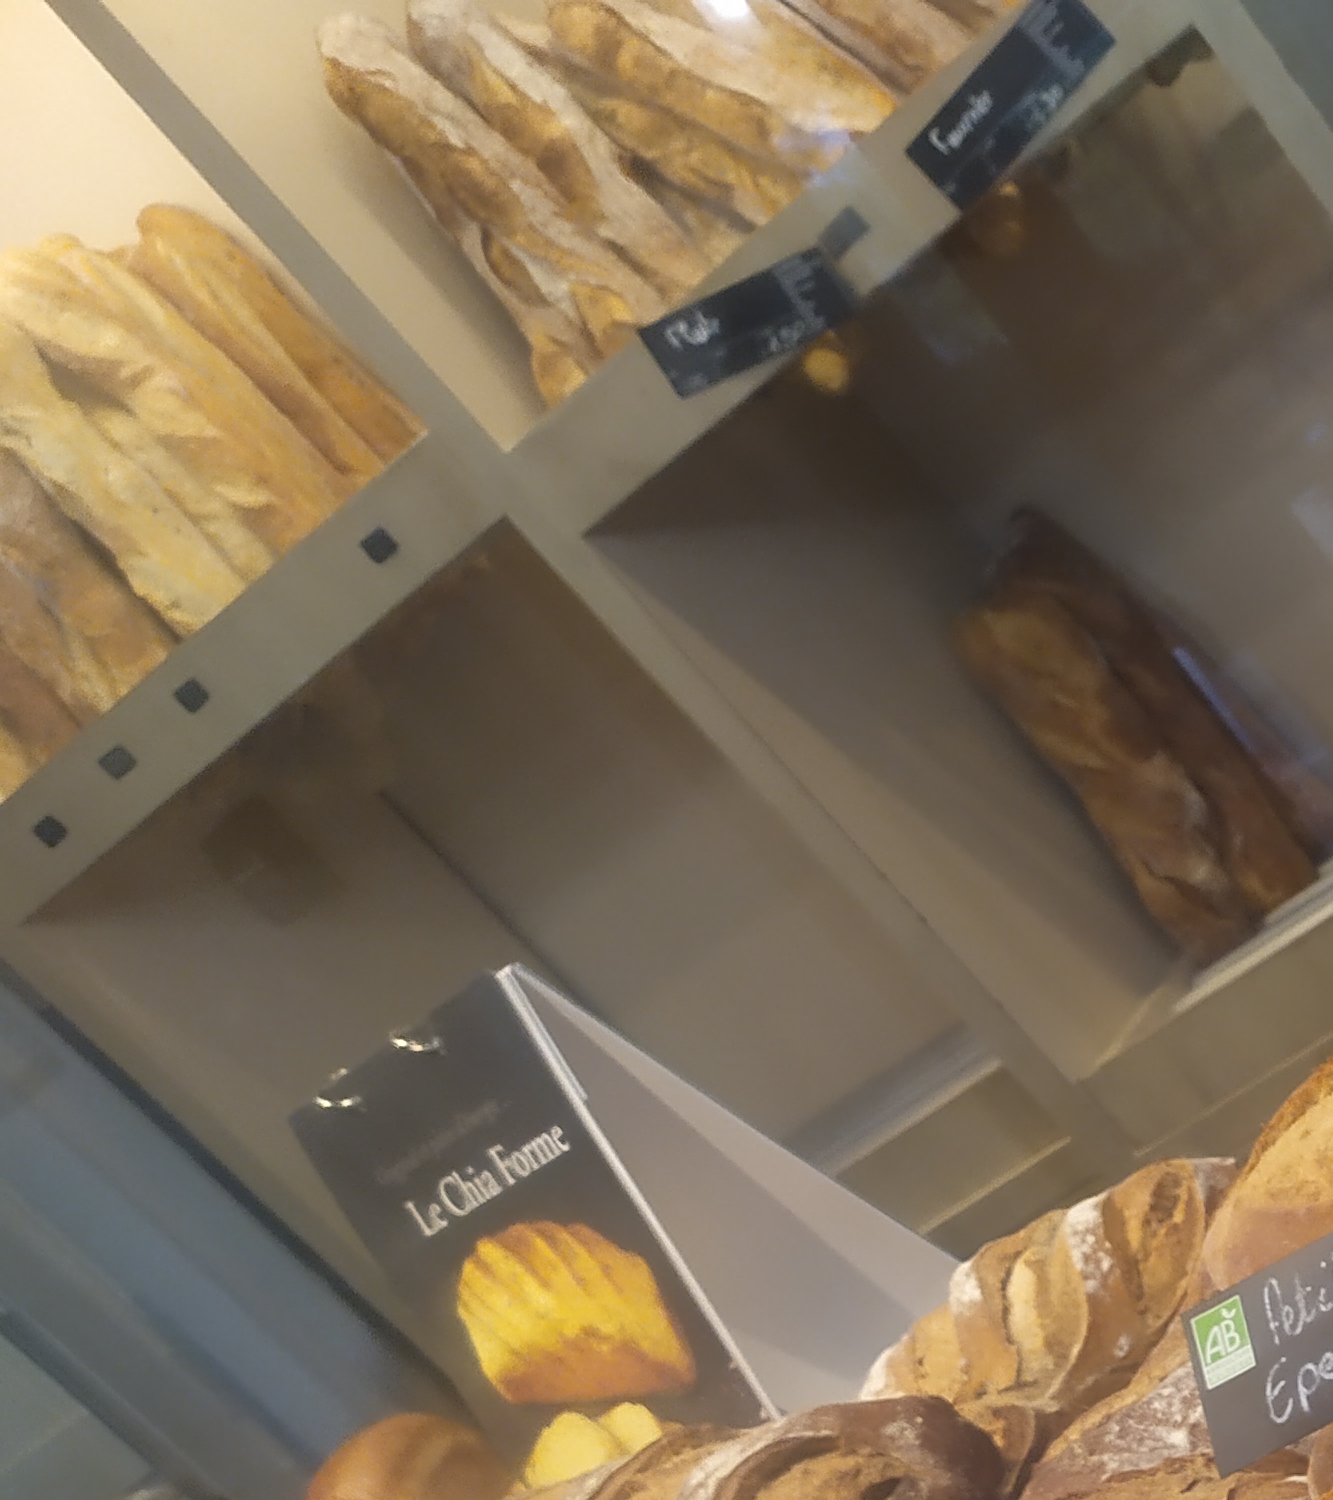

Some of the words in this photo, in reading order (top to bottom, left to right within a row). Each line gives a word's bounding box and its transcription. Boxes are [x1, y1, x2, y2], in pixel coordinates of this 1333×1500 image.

[405, 1201, 448, 1236] Le
[438, 1167, 502, 1217] Chia
[487, 1125, 570, 1186] Forme
[1206, 1320, 1240, 1363] AB
